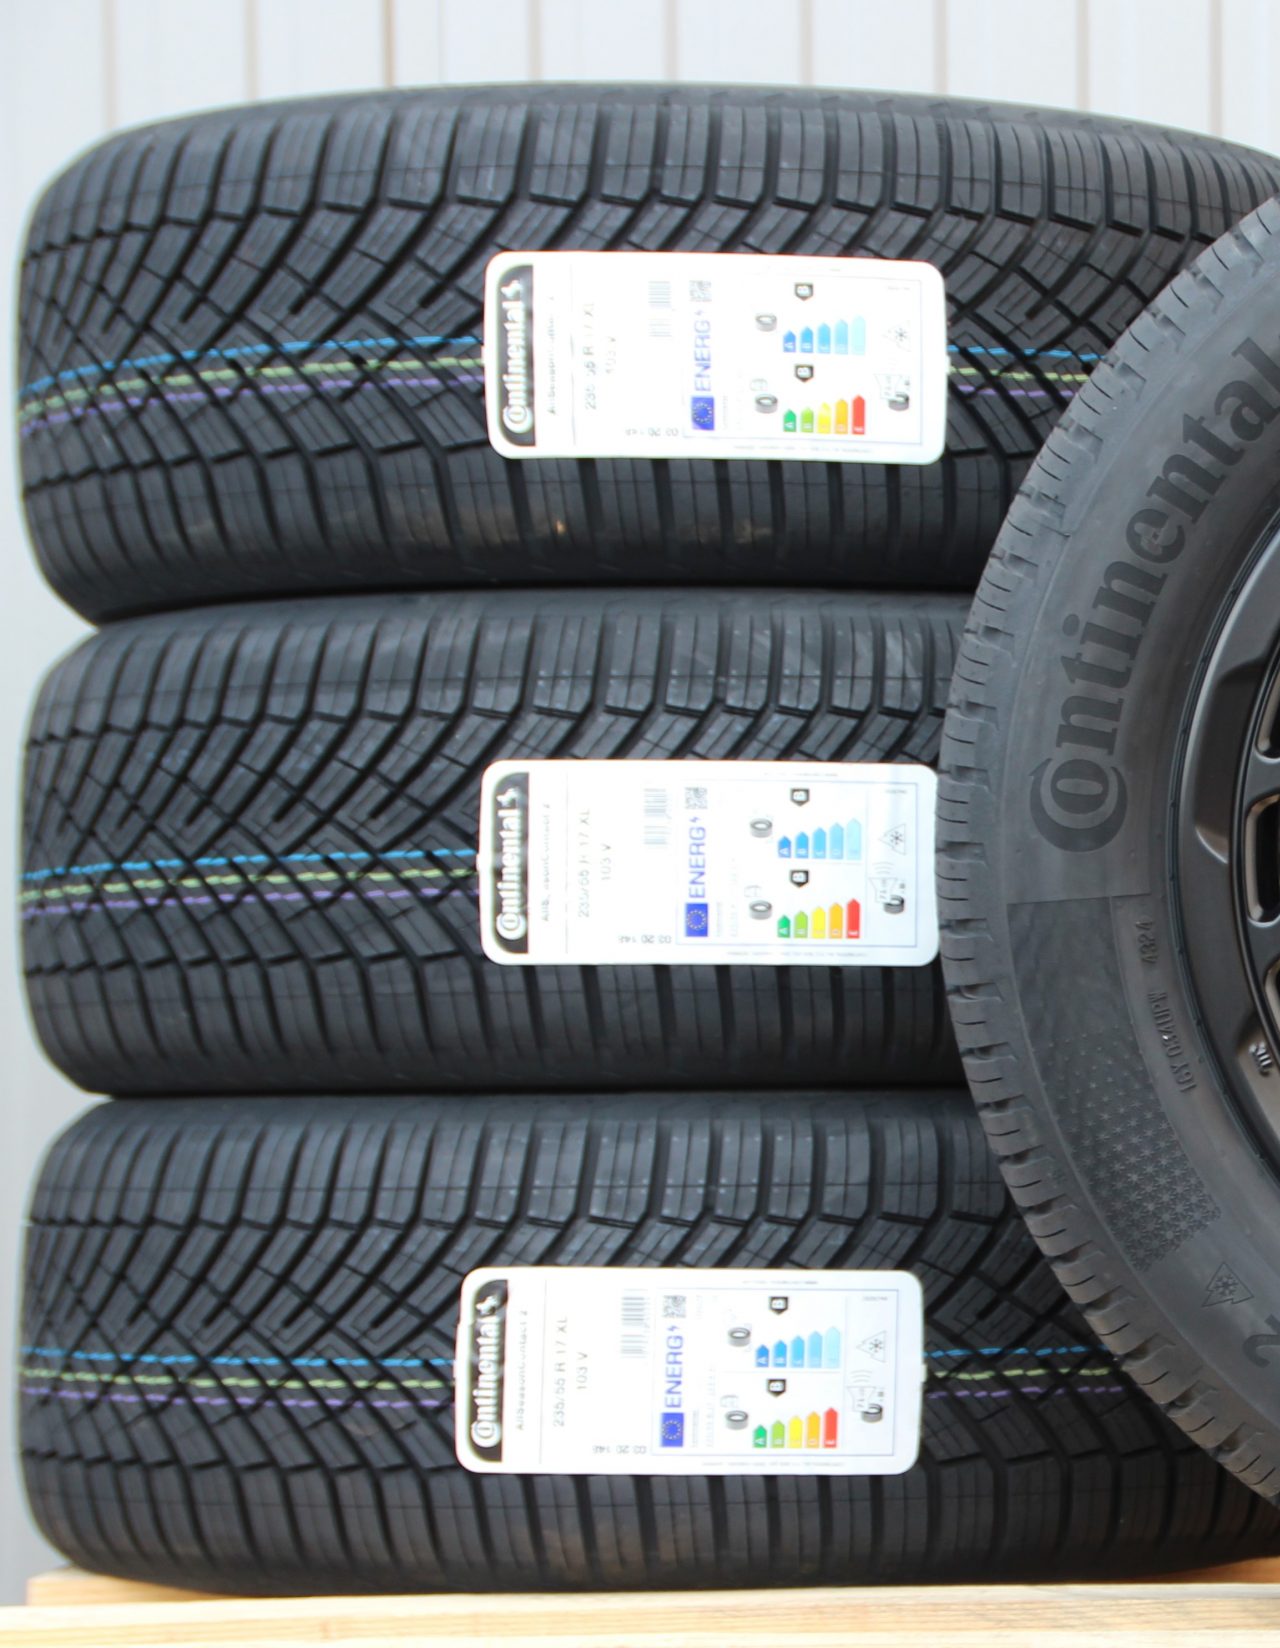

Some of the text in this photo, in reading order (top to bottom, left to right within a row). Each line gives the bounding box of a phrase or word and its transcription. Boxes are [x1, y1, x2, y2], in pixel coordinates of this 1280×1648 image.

[503, 301, 531, 430] Continental
[694, 320, 711, 392] ENERG
[497, 810, 524, 938] Continental
[688, 826, 706, 899] ENERG
[472, 1317, 499, 1446] Continental
[664, 1335, 684, 1408] ENERG
